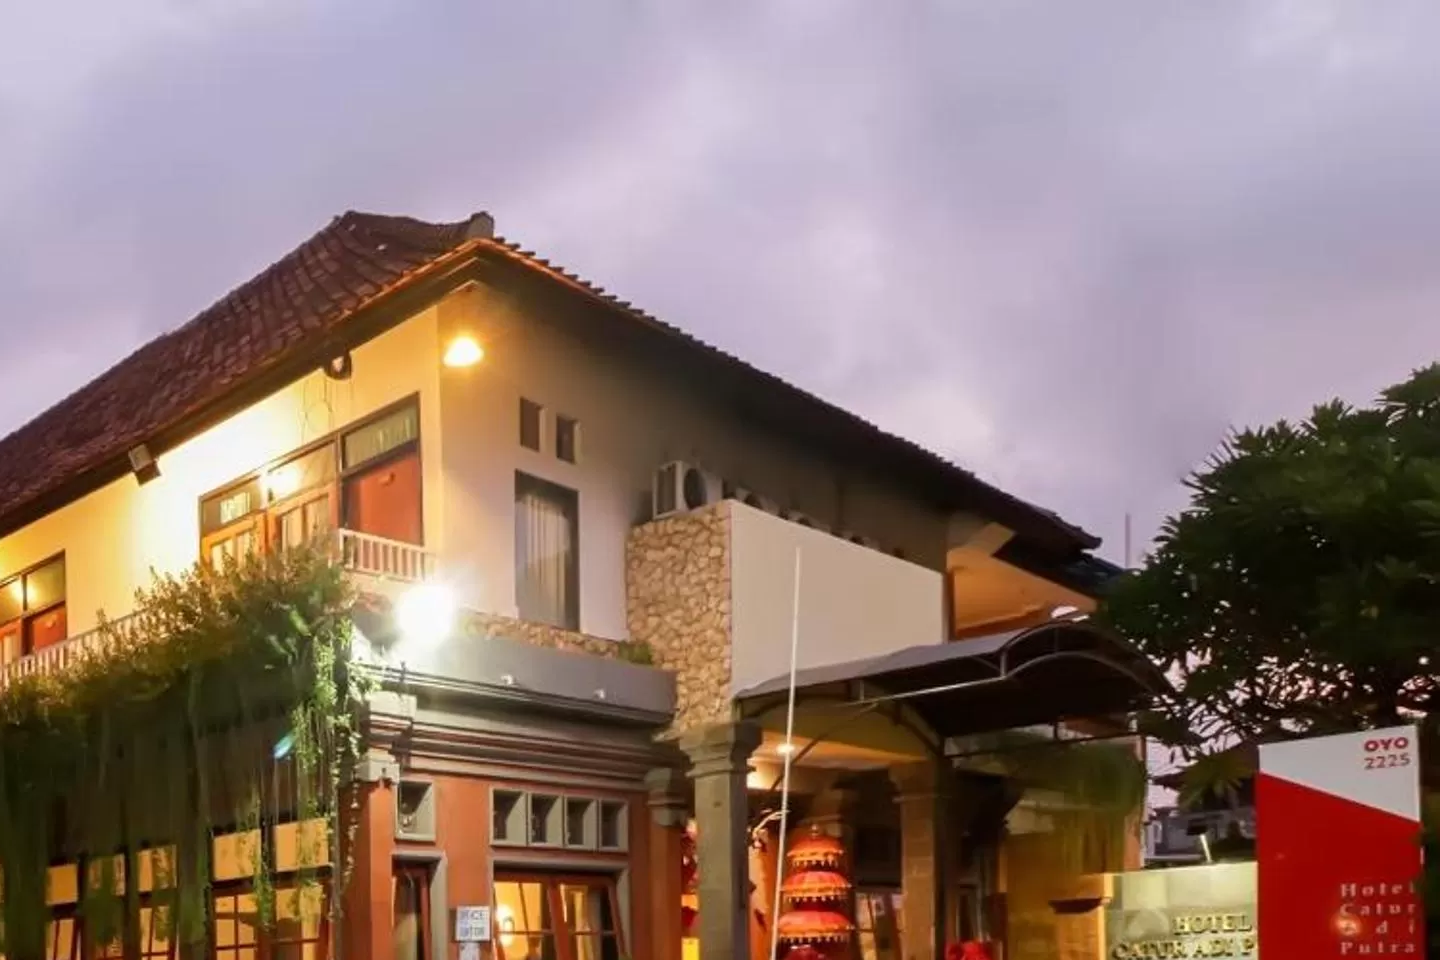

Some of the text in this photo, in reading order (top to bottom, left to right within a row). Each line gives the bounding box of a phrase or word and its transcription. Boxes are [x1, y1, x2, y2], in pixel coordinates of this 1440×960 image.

[1364, 737, 1408, 752] OYO
[1364, 753, 1410, 770] 2225
[1341, 881, 1415, 898] Hotel
[1340, 903, 1416, 917] Catur
[1173, 914, 1252, 935] HOTEL
[1112, 940, 1187, 960] CATUR
[1193, 938, 1233, 957] ADI
[1341, 941, 1415, 955] Putra
